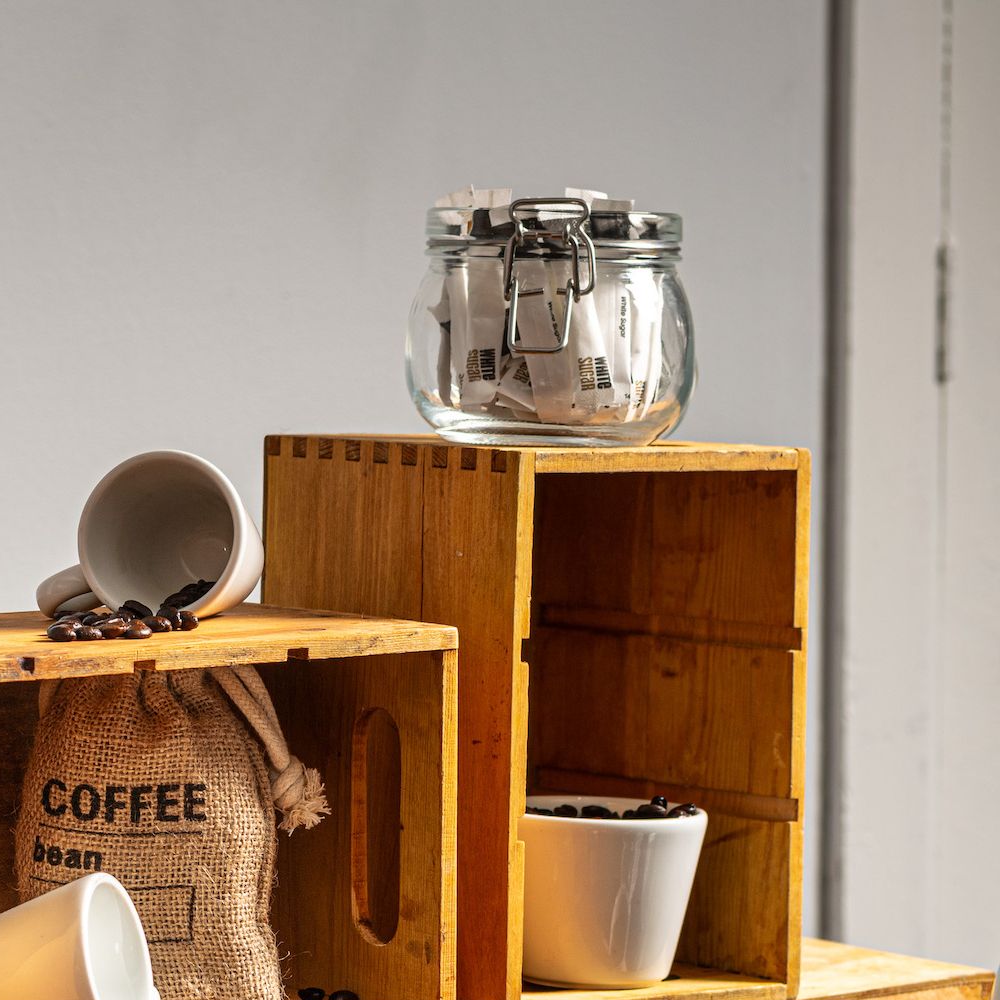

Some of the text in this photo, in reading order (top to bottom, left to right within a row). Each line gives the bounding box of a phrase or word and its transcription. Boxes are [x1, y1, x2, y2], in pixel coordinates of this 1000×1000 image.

[618, 318, 627, 338] Sugar
[41, 778, 207, 824] COFFEE
[32, 836, 102, 871] bean
